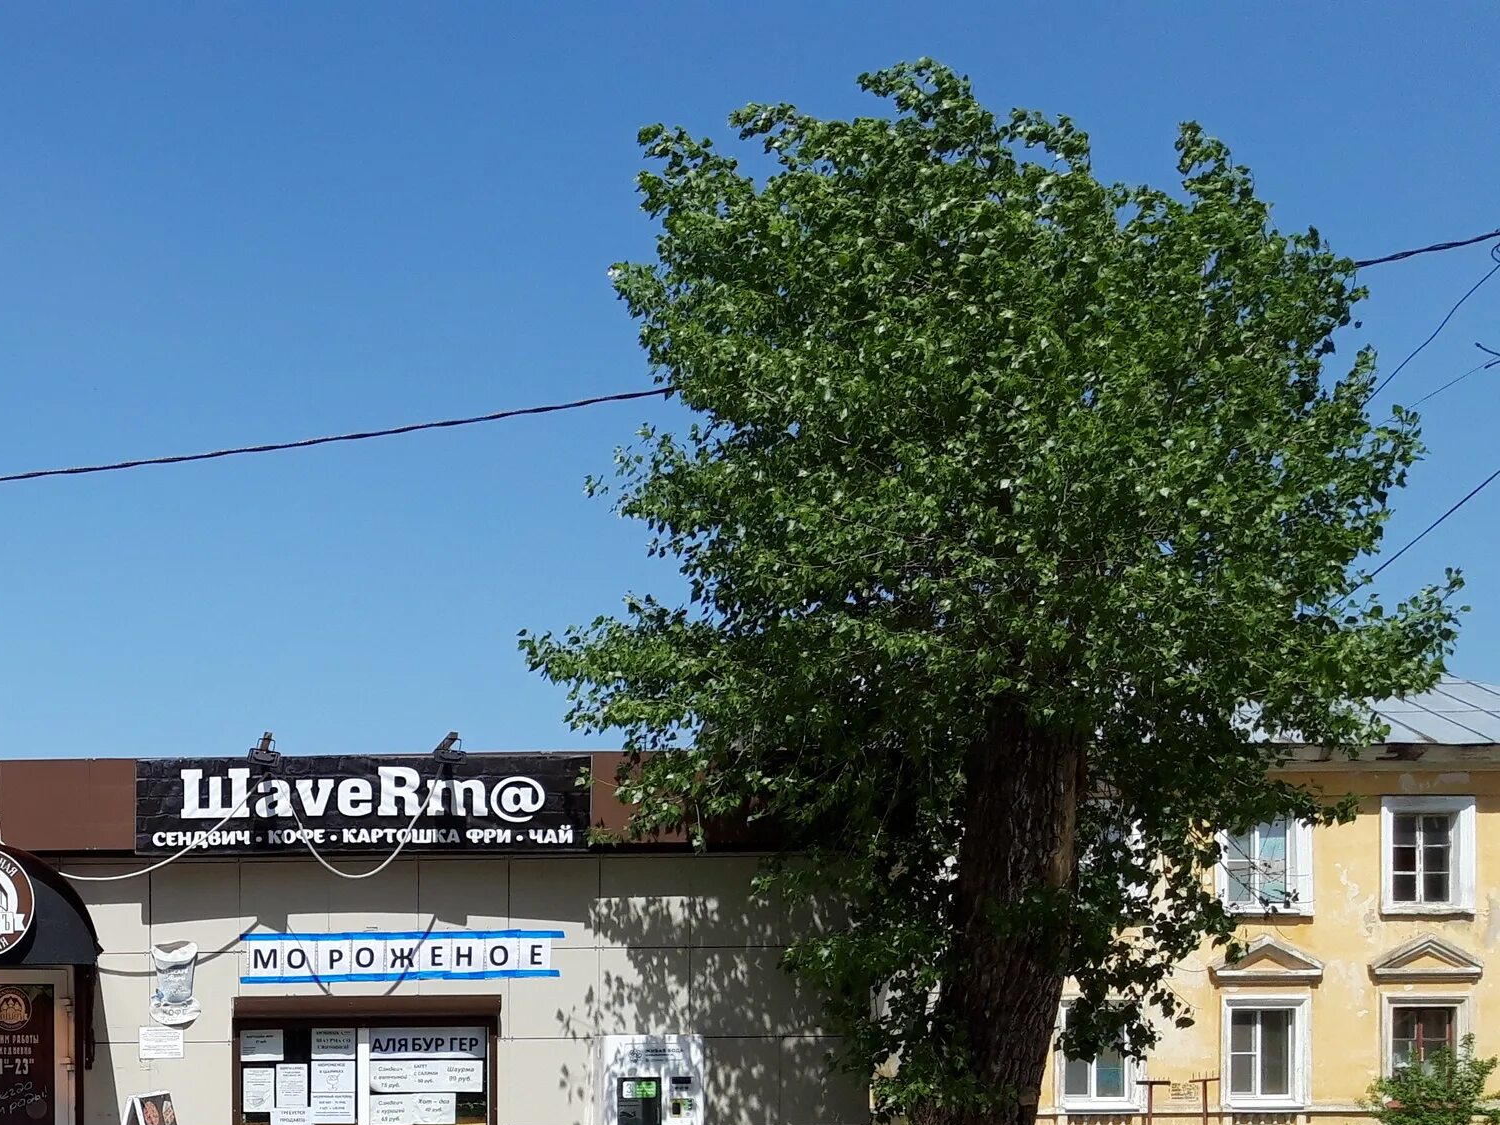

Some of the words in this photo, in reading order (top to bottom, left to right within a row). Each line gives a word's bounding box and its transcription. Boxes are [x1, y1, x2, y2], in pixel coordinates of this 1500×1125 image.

[152, 830, 251, 849] СЕНДВИЧ
[268, 828, 326, 845] КОФЕ
[342, 828, 460, 844] КАРТОШКА
[465, 828, 512, 844] ФРИ
[528, 824, 574, 844] ЧАЙ
[253, 944, 543, 969] МОРОЖЕНОЕ
[12, 1034, 39, 1044] РАБОТЫ
